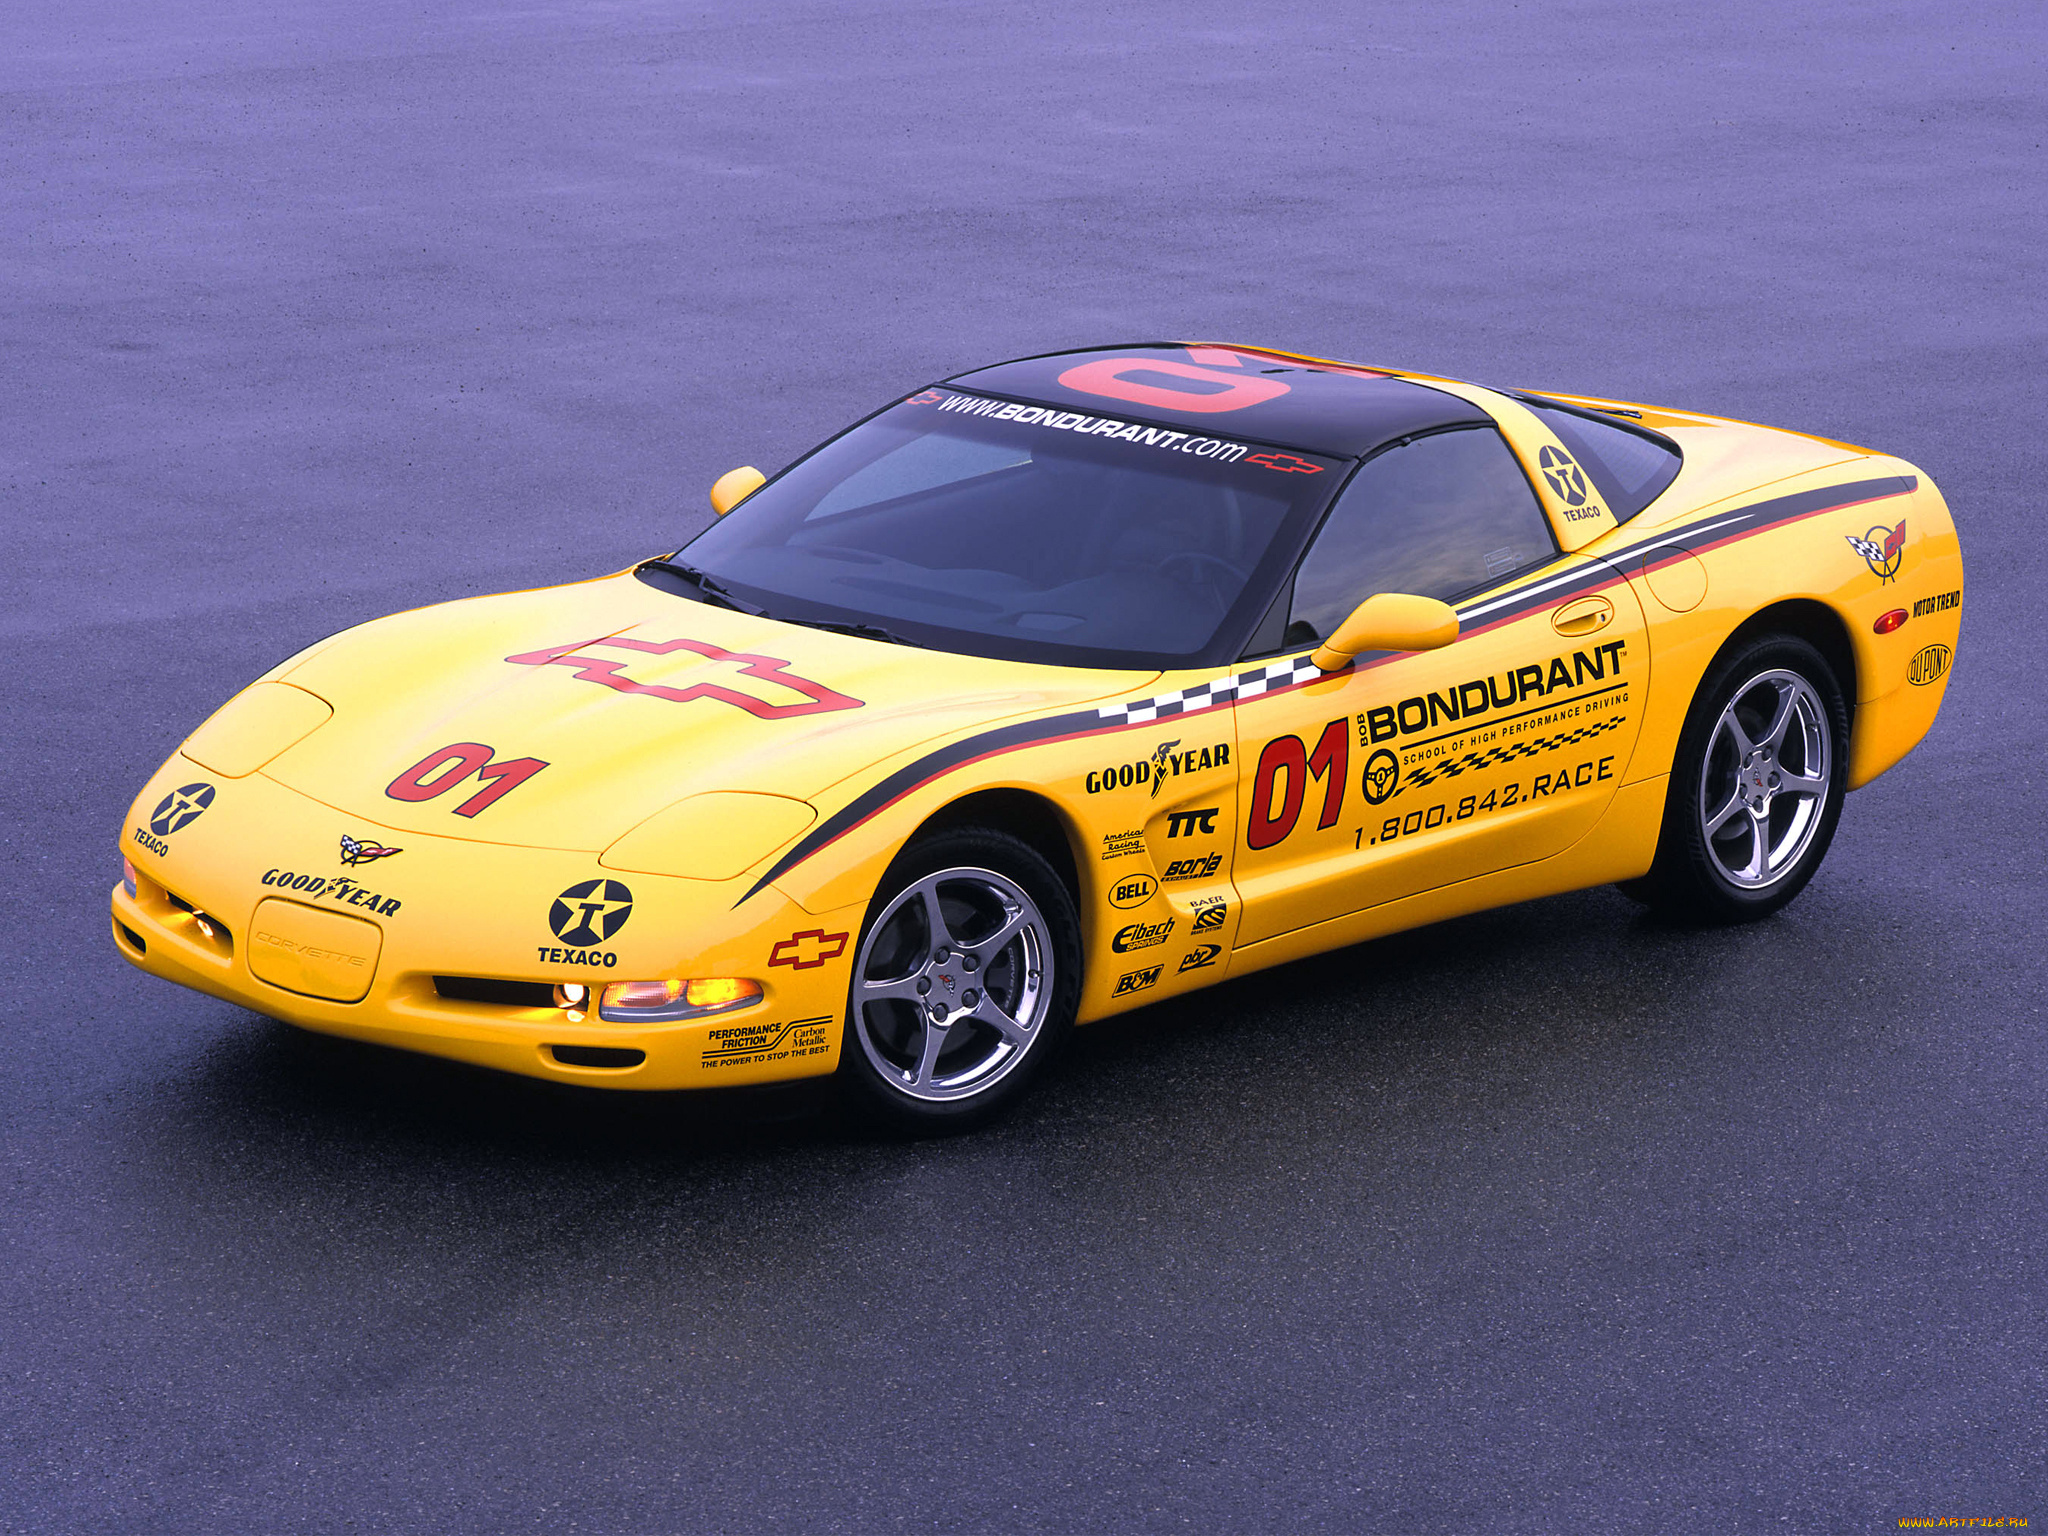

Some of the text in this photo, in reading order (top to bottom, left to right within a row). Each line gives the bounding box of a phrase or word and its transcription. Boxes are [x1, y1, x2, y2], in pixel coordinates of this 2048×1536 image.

[937, 395, 1247, 463] www.BONDURANT.com
[1563, 506, 1600, 522] TEXACO
[1913, 590, 1960, 618] MOTOR TREND
[1367, 640, 1625, 744] BONDURANT
[1357, 713, 1369, 747] BOB
[1404, 693, 1629, 765] SCHOOL OF HIGH PERFORMANCE DRIVING
[385, 742, 551, 818] 01
[1247, 716, 1349, 851] 01
[1354, 755, 1615, 850] 1.800.842.RACE
[1167, 807, 1219, 838] TTC
[133, 827, 169, 858] TEXACO
[1108, 840, 1140, 851] Racing
[1116, 882, 1149, 901] BELL
[1189, 895, 1225, 908] BAER
[255, 930, 367, 967] CORVETTE
[1111, 916, 1176, 954] Eibach
[537, 946, 618, 969] TEXACO
[1115, 967, 1162, 994] B&M
[708, 1022, 782, 1041] PERFORMANCE
[721, 1035, 767, 1050] FRICTION
[791, 1036, 827, 1049] Metallic
[793, 1027, 826, 1039] Carbon
[701, 1044, 831, 1069] THE POWER TO STOP THE BEST
